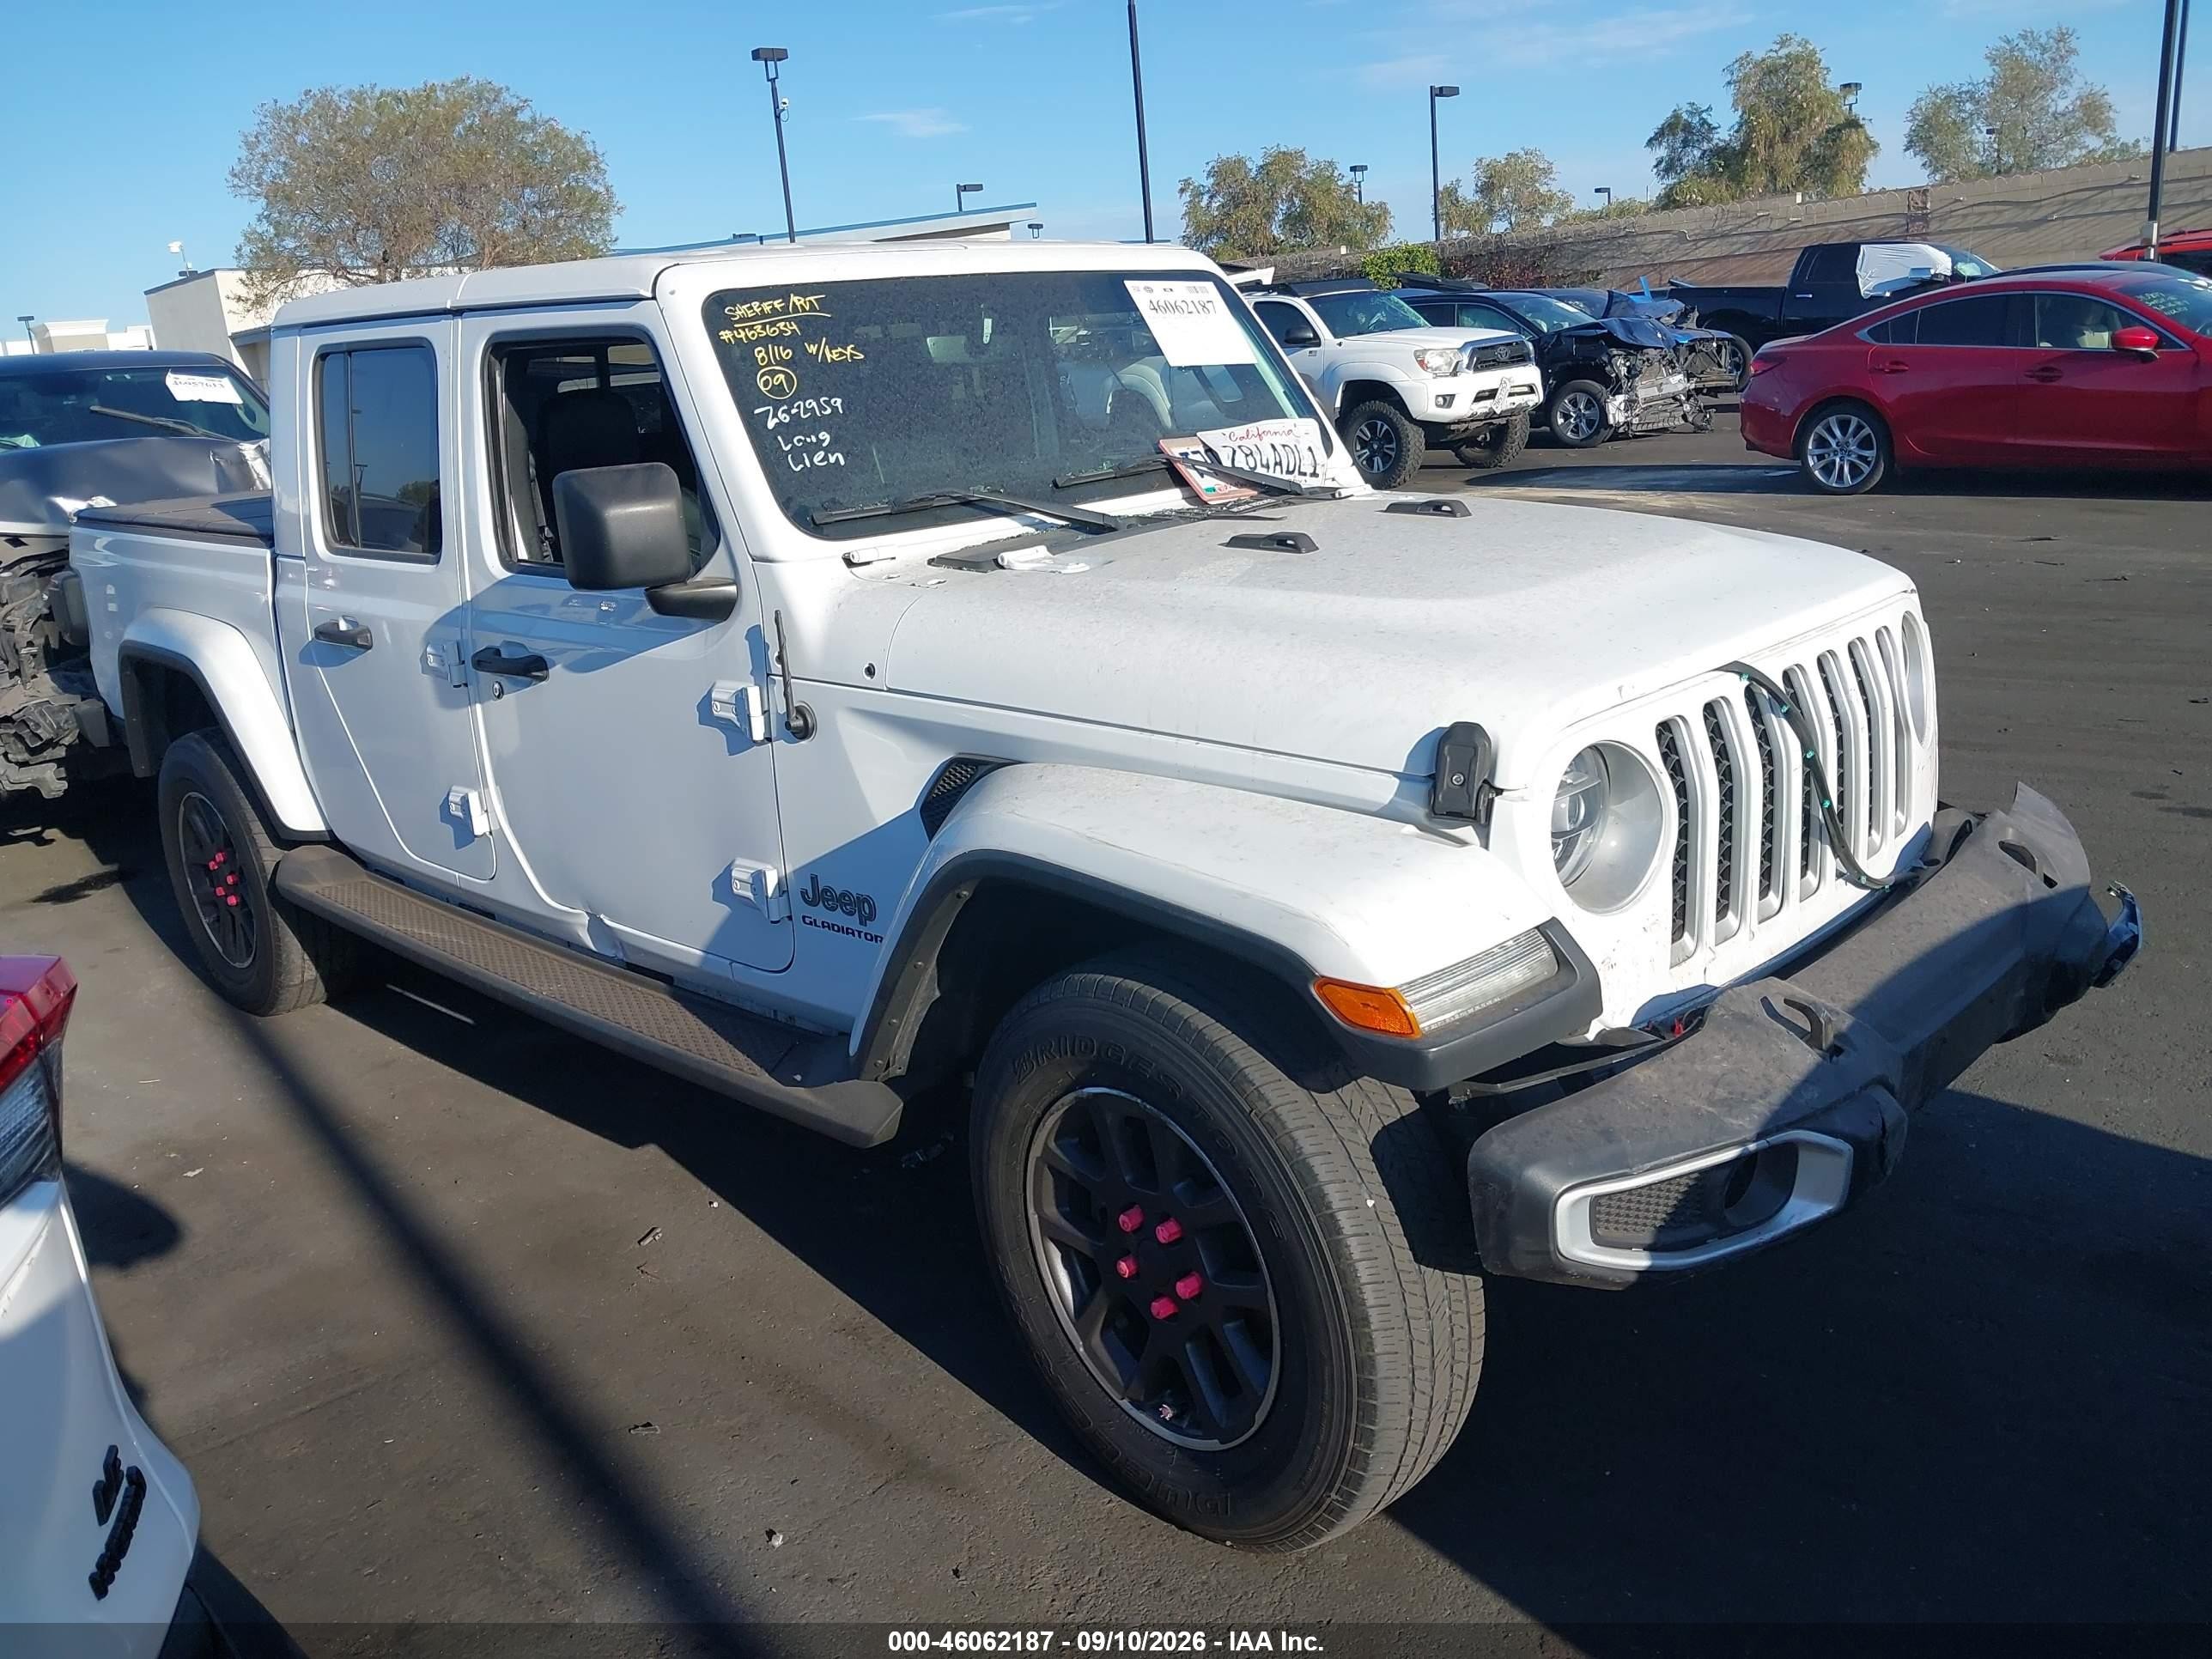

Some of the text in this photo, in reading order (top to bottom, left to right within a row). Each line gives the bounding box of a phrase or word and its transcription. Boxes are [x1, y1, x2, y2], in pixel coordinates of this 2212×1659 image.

[724, 298, 785, 321] SHERIFF
[1149, 299, 1216, 315] 46062187
[719, 321, 801, 344] #463634
[799, 872, 877, 927] Jeep
[801, 914, 884, 945] GLADIATOR
